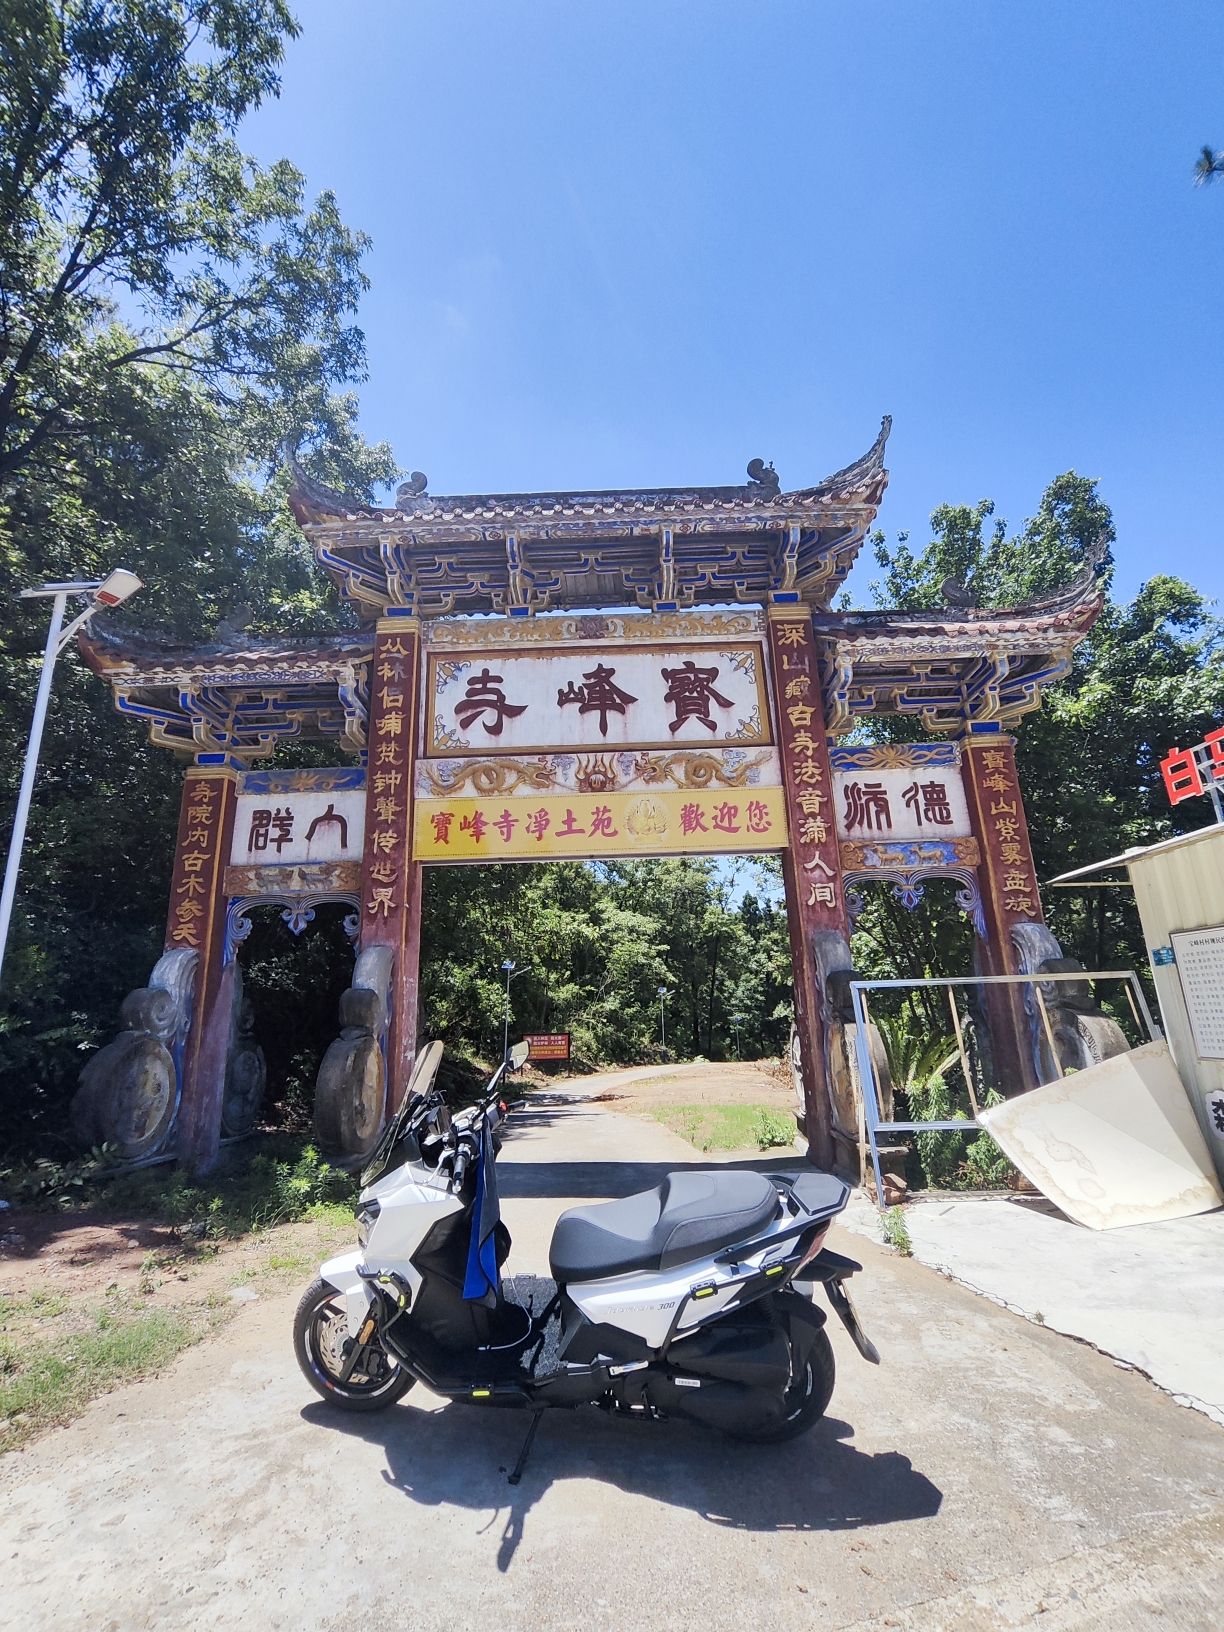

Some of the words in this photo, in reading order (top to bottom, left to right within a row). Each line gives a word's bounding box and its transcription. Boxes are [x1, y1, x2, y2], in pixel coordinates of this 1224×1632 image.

[454, 660, 735, 737] 寶峰寺
[679, 801, 772, 836] 歡迎您
[657, 1302, 675, 1311] 300
